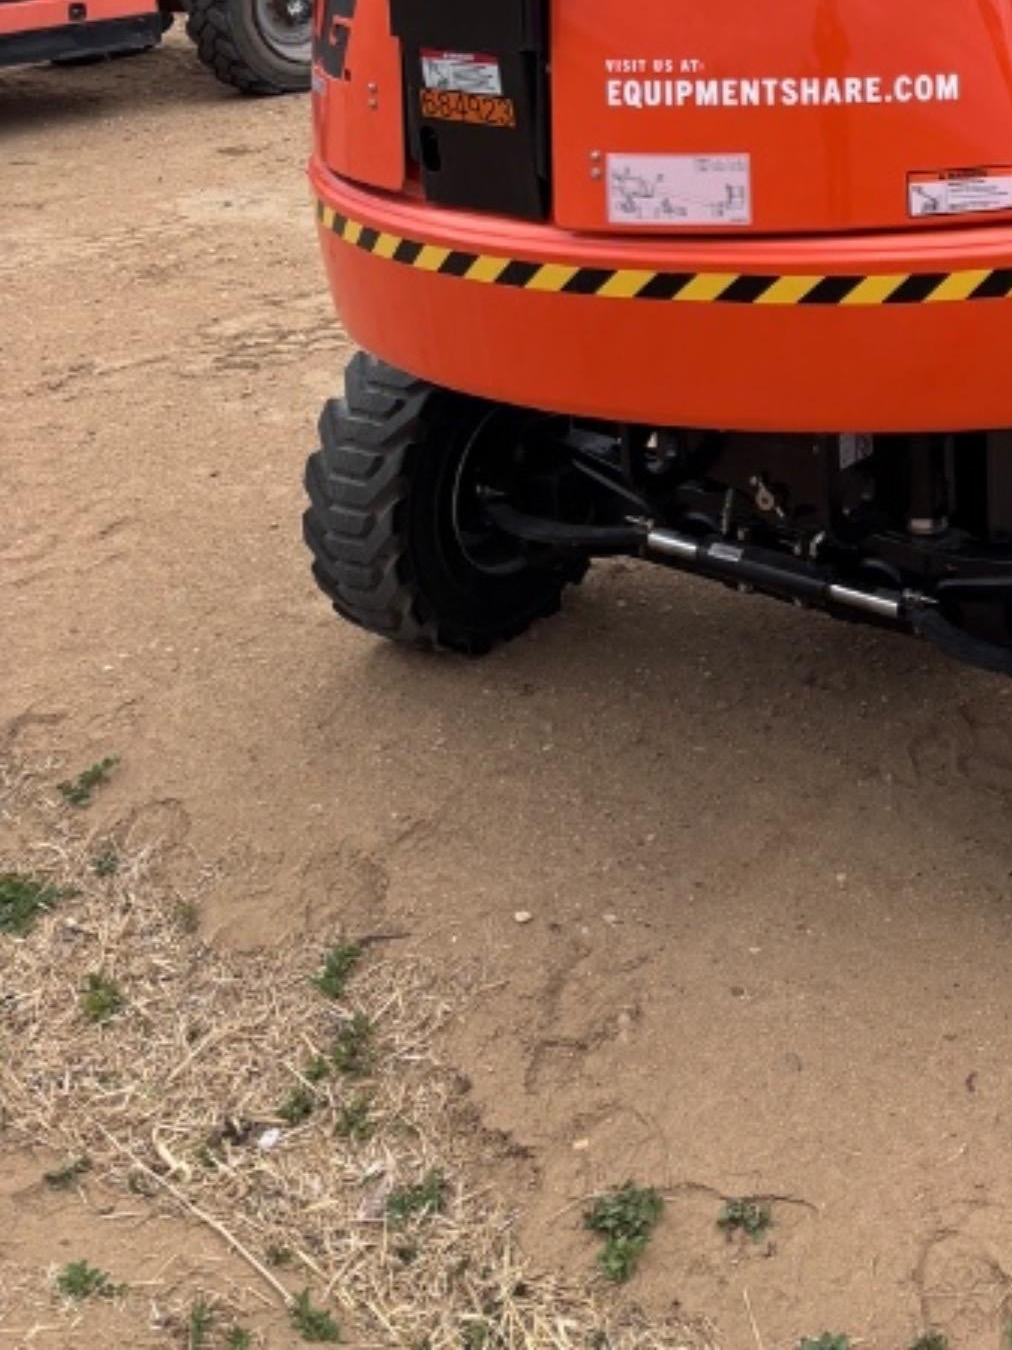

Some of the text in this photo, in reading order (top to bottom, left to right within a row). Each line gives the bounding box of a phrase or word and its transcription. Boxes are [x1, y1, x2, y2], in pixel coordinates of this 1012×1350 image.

[605, 59, 646, 73] VISIT
[652, 59, 673, 73] US
[606, 73, 960, 109] EQUIPMENTSHARE.COM
